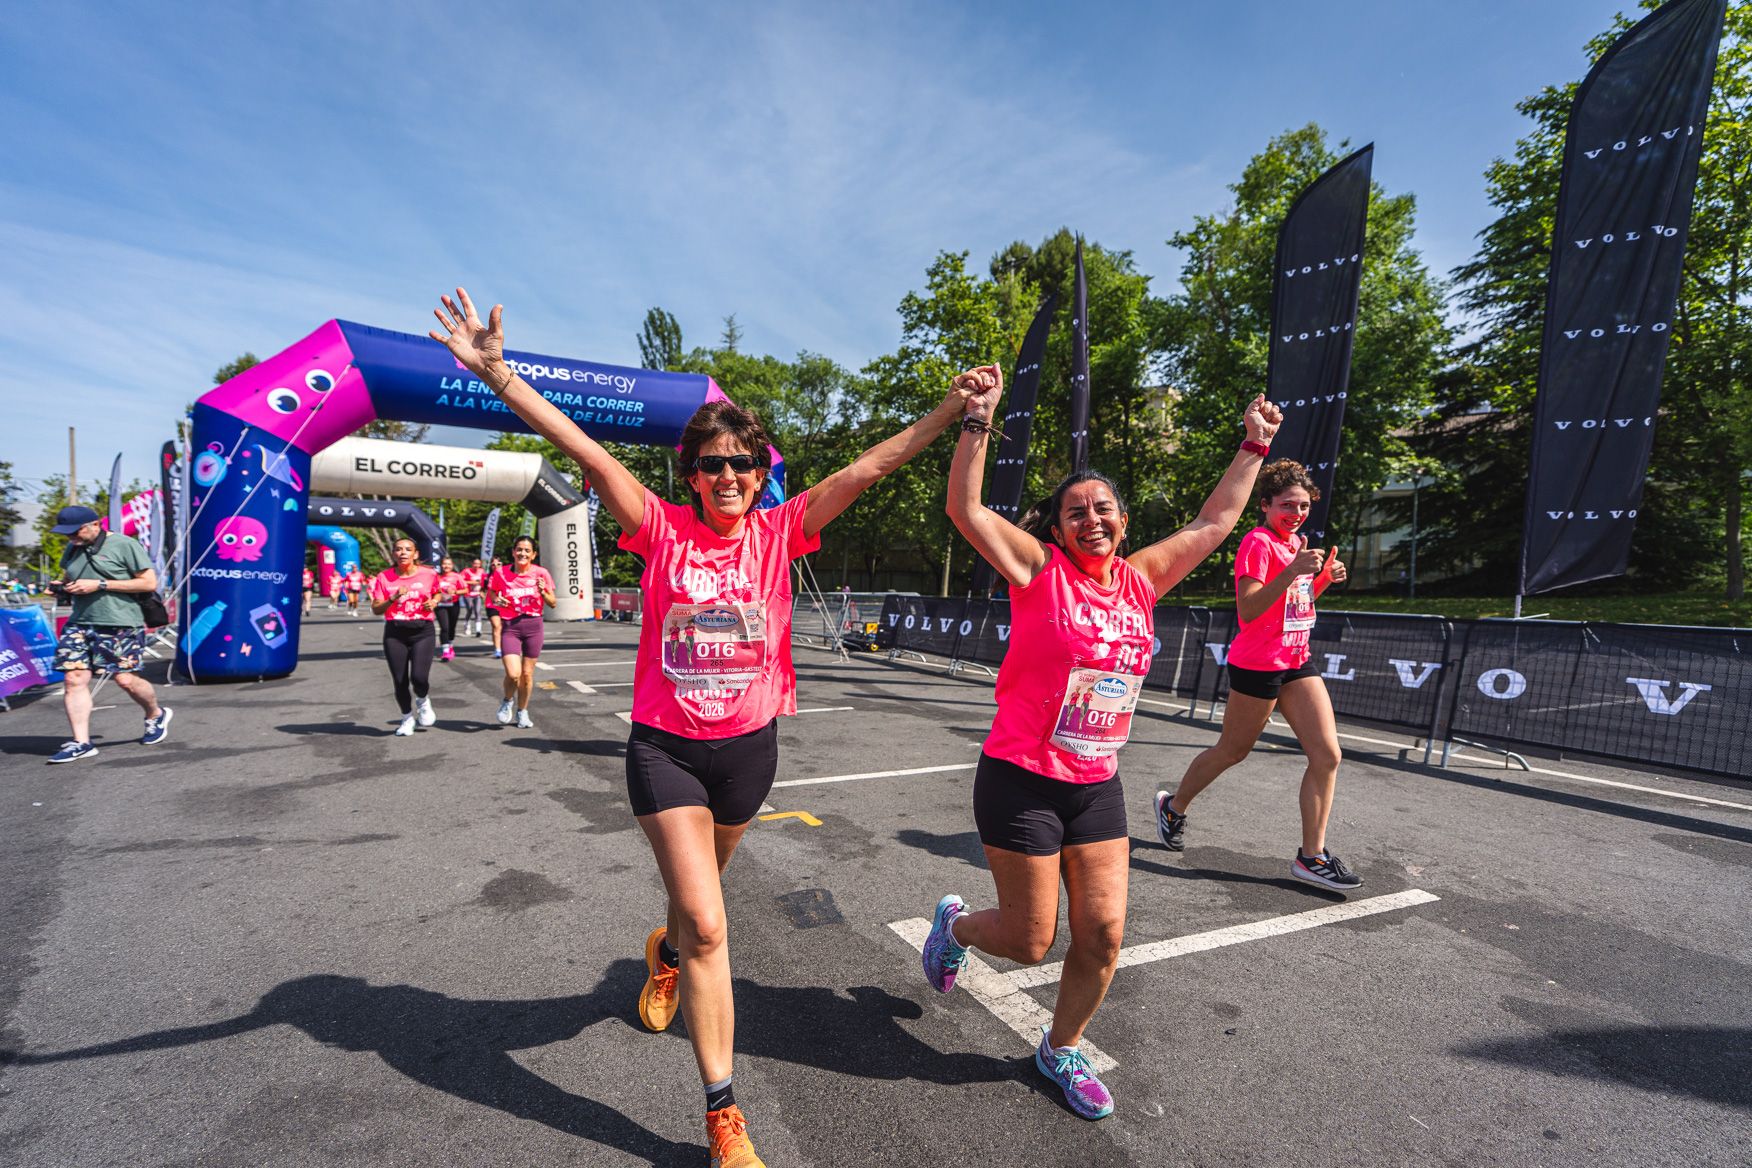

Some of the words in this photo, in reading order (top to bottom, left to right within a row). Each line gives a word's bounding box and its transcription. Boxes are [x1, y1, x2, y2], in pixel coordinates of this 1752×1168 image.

[1575, 223, 1678, 249] VOLVO
[1285, 253, 1358, 277] VOLVO
[1282, 322, 1351, 343] VOLVO
[503, 360, 571, 381] topus
[572, 369, 637, 394] energy
[440, 377, 463, 391] LA
[543, 390, 583, 406] PARA
[587, 396, 645, 413] CORRER
[1278, 391, 1348, 408] VOLVO
[436, 394, 450, 405] A
[453, 396, 475, 409] LA
[572, 409, 594, 422] DE
[597, 413, 614, 424] LA
[617, 415, 645, 427] LUZ
[355, 457, 383, 473] EL
[387, 461, 477, 480] CORREO
[308, 505, 396, 518] OLVO
[484, 513, 497, 557] AMUTIO
[566, 524, 577, 539] EL
[242, 570, 288, 584] energy
[567, 543, 579, 595] CORREO
[888, 613, 973, 636] VOLVO
[696, 643, 736, 657] 016
[699, 702, 725, 717] 2026
[1087, 710, 1117, 727] 016
[1060, 740, 1089, 751] OYSHO
